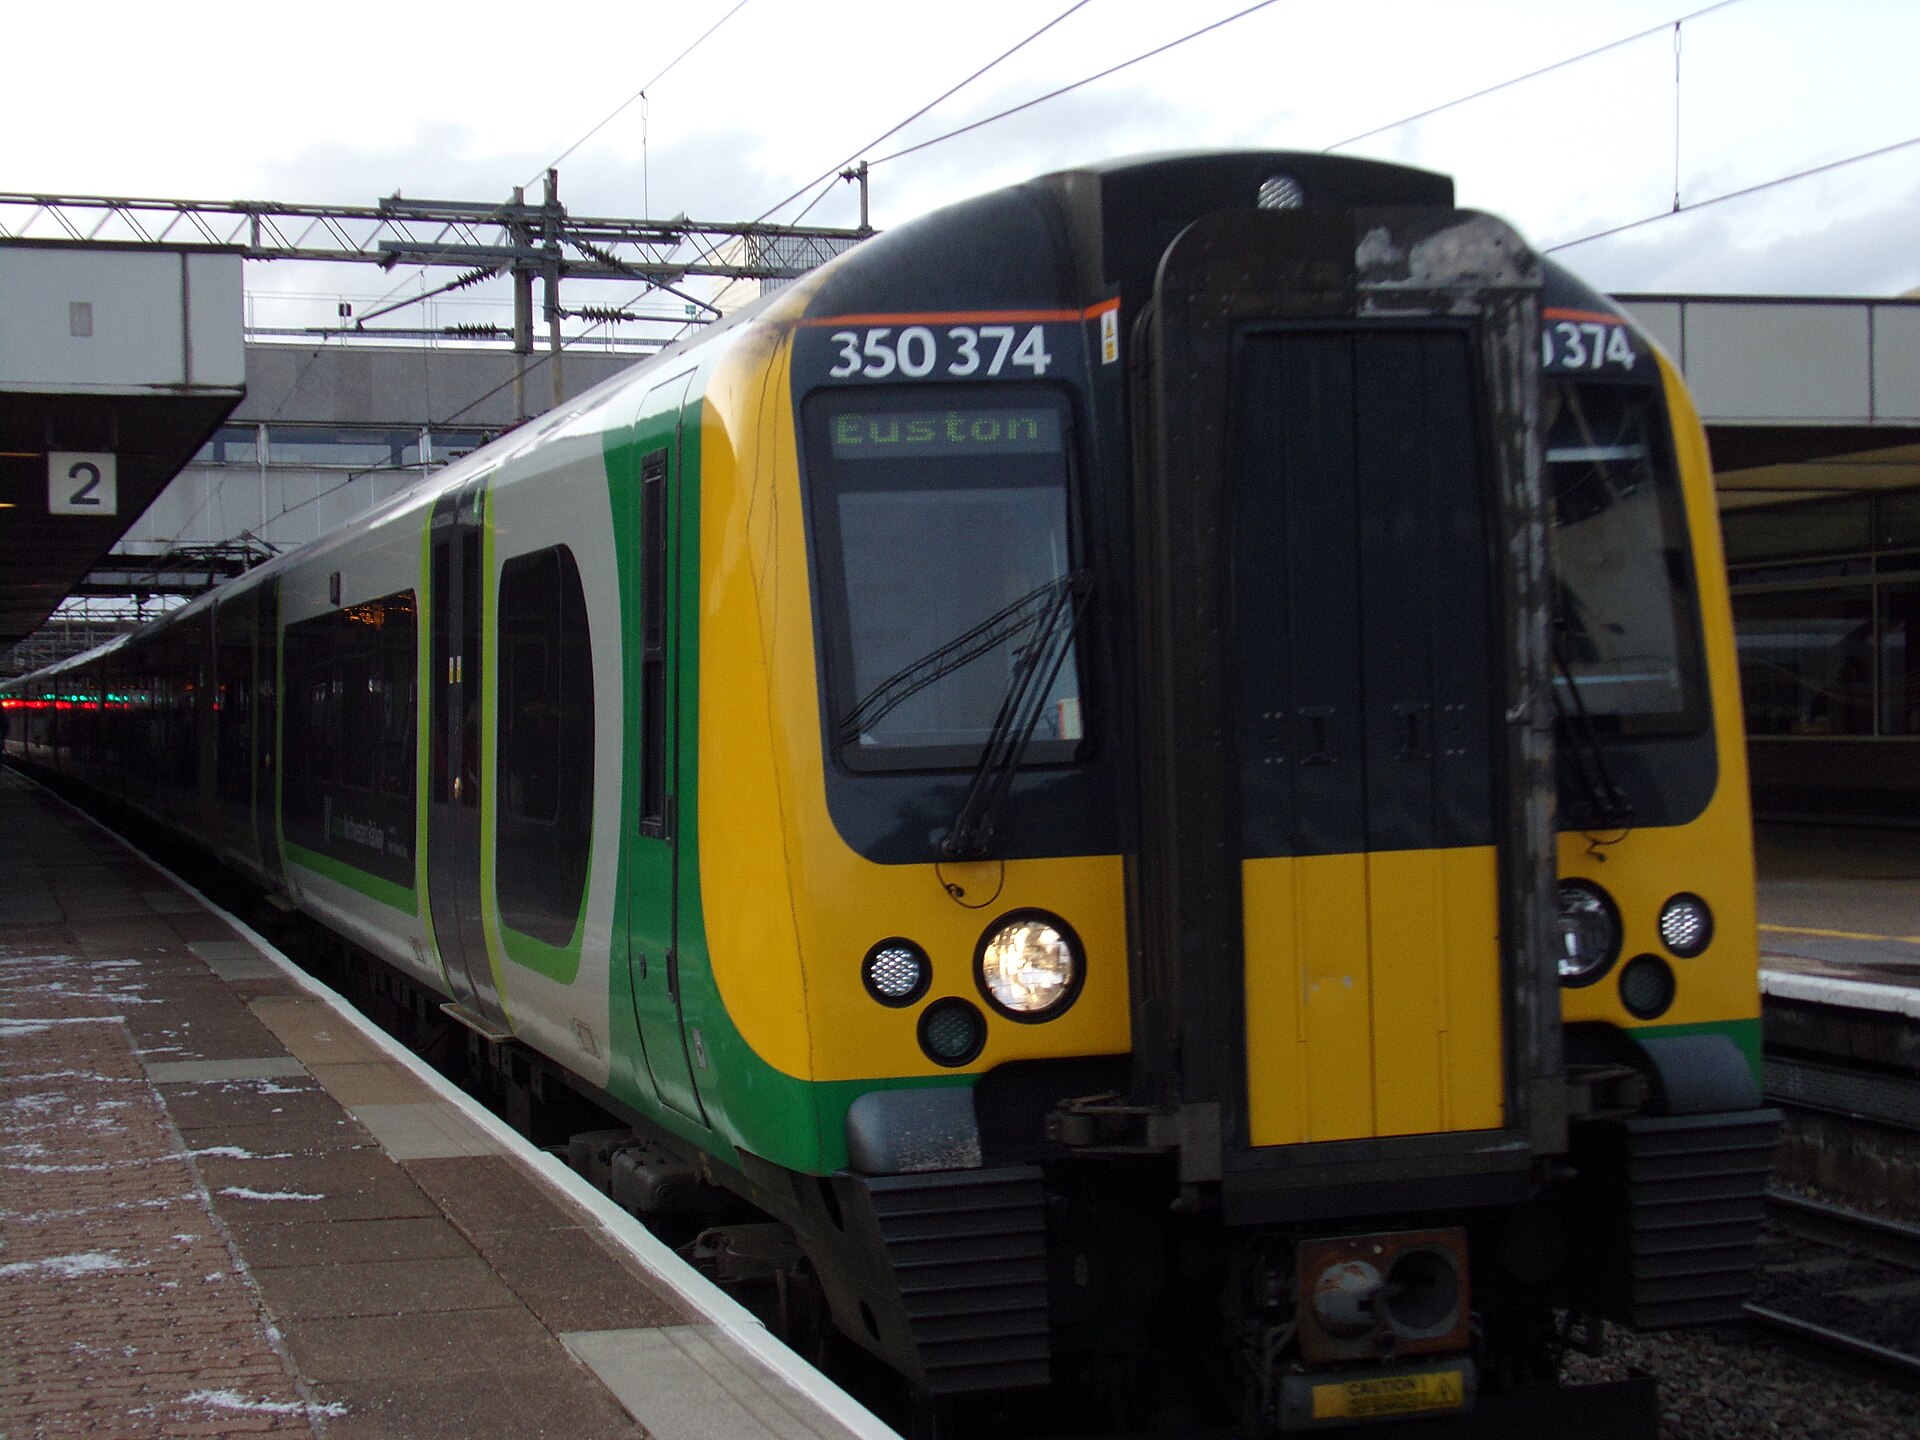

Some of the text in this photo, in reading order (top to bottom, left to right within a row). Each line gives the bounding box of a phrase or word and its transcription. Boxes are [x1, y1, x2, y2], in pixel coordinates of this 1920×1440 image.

[829, 325, 1051, 378] 350 374
[1555, 321, 1636, 371] 374
[836, 411, 1038, 444] Euston
[68, 461, 100, 505] 2
